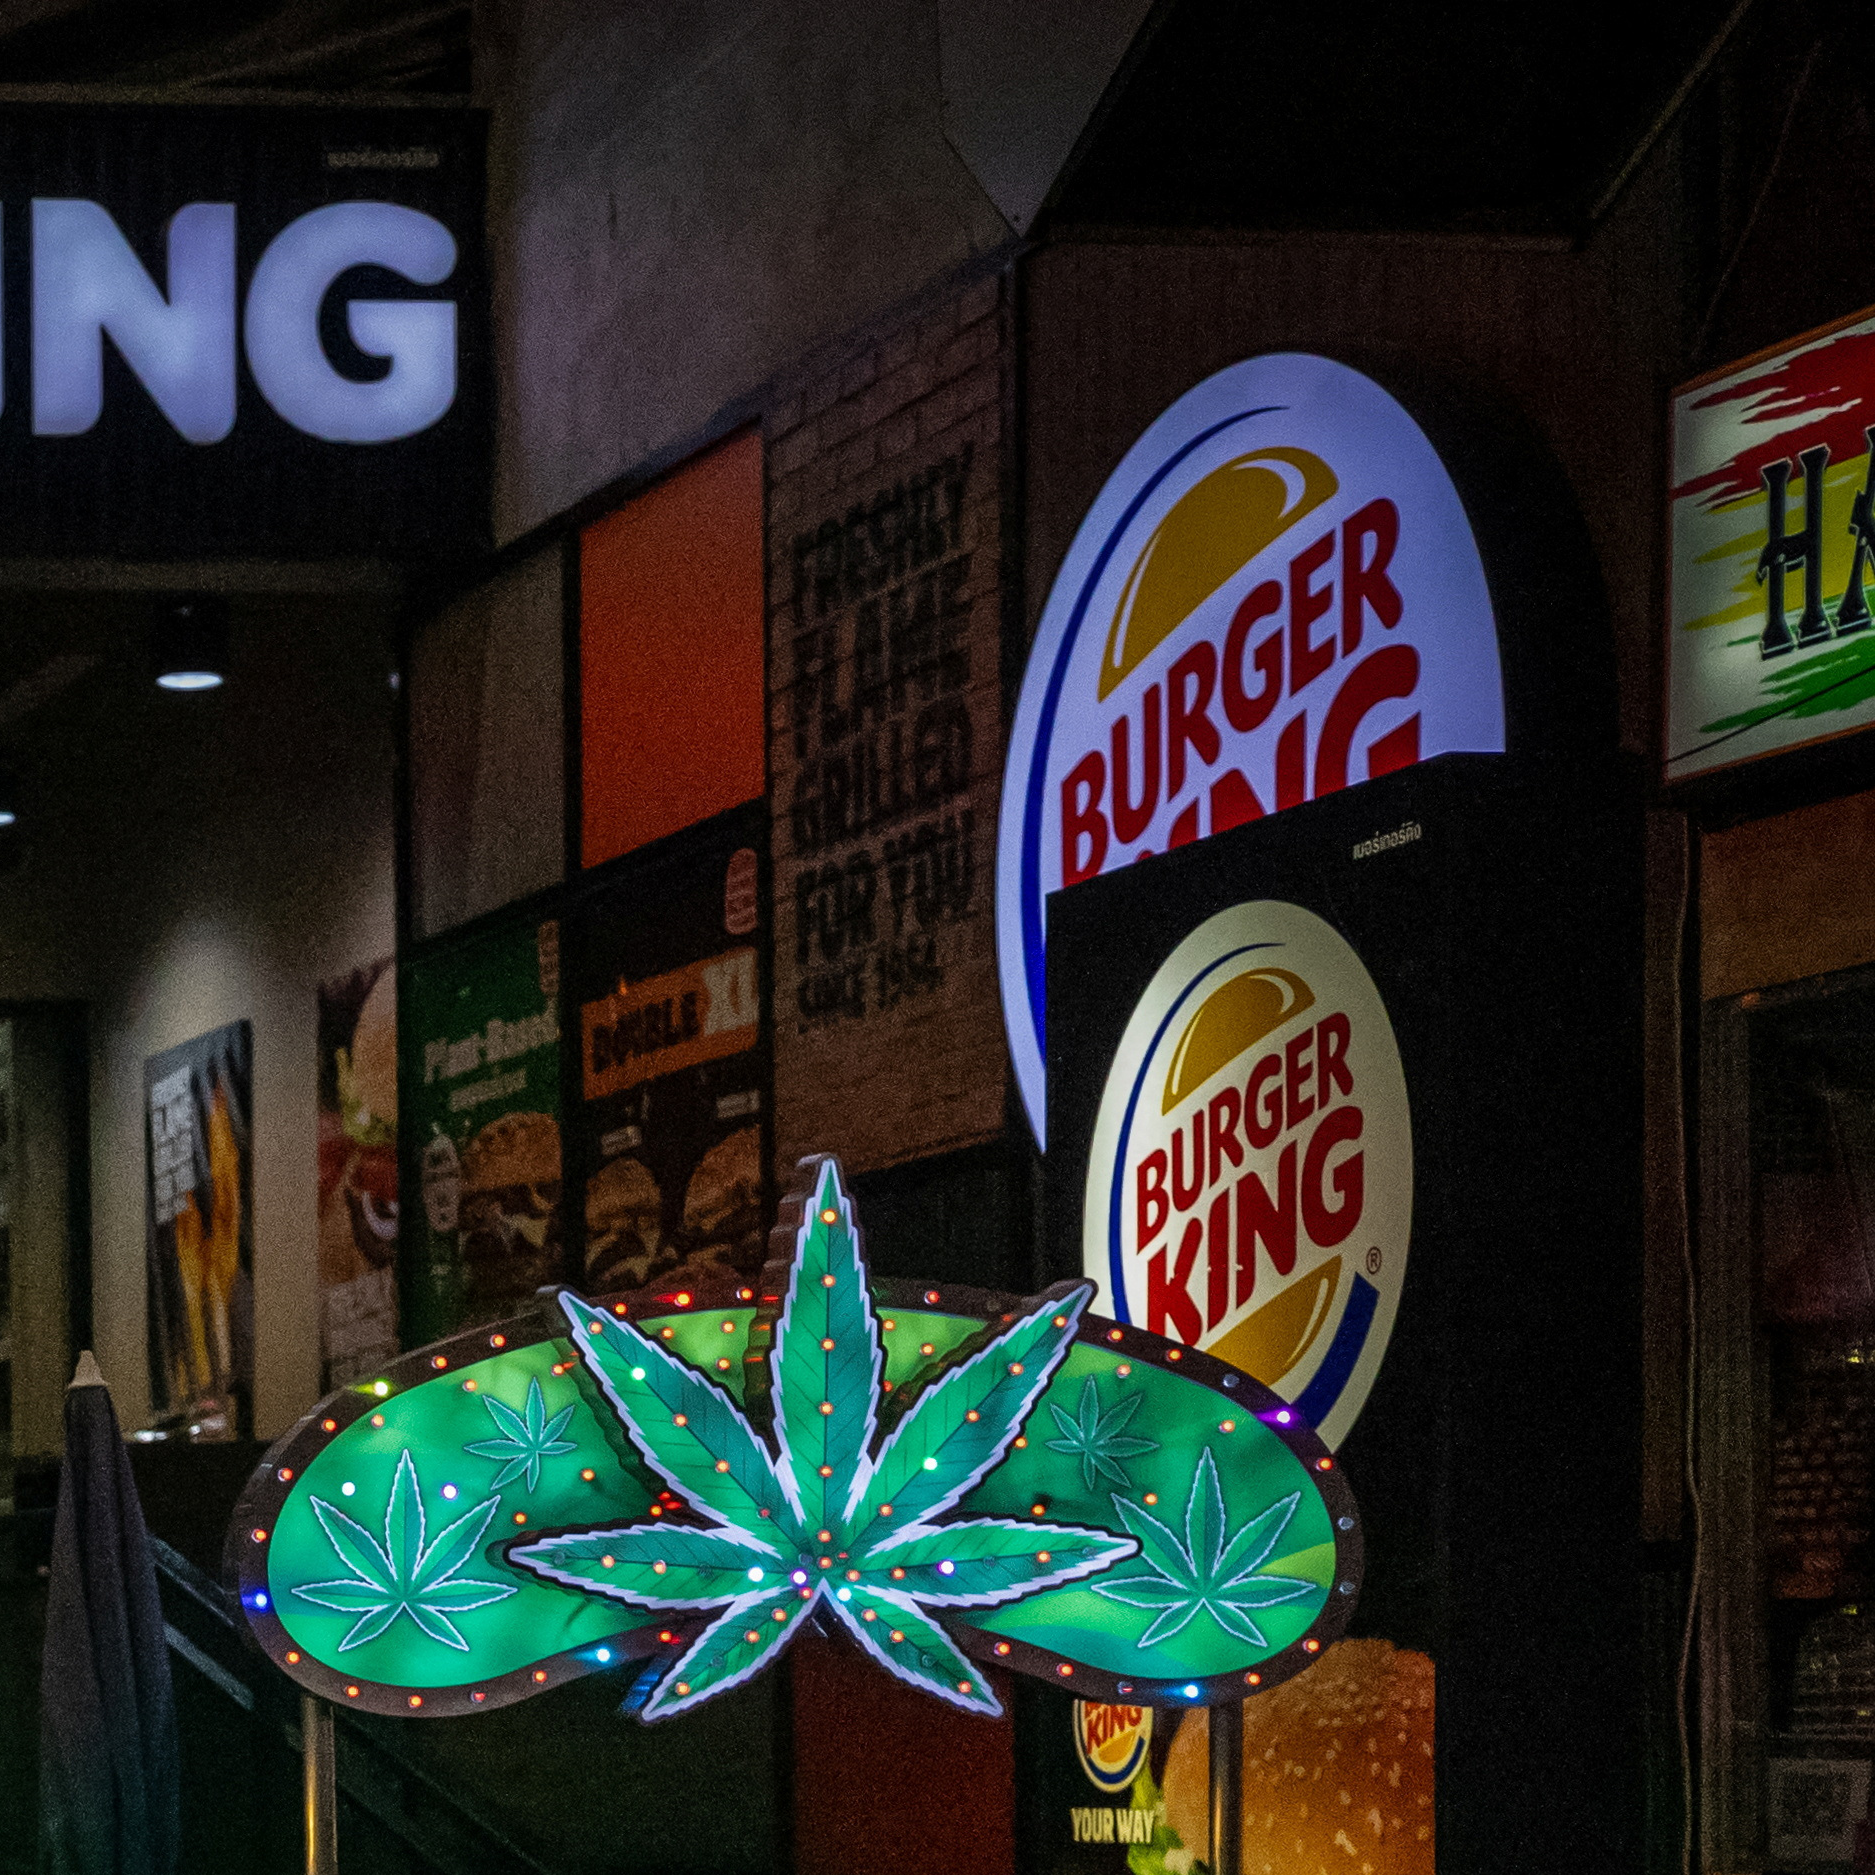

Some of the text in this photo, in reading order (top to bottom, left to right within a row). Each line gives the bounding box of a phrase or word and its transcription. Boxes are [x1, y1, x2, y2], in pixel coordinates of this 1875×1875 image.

[1061, 497, 1403, 889] BURGER
[1136, 1012, 1354, 1256] BURGER
[1147, 1105, 1364, 1348] KING
[1070, 1806, 1156, 1844] YOUR WAY
